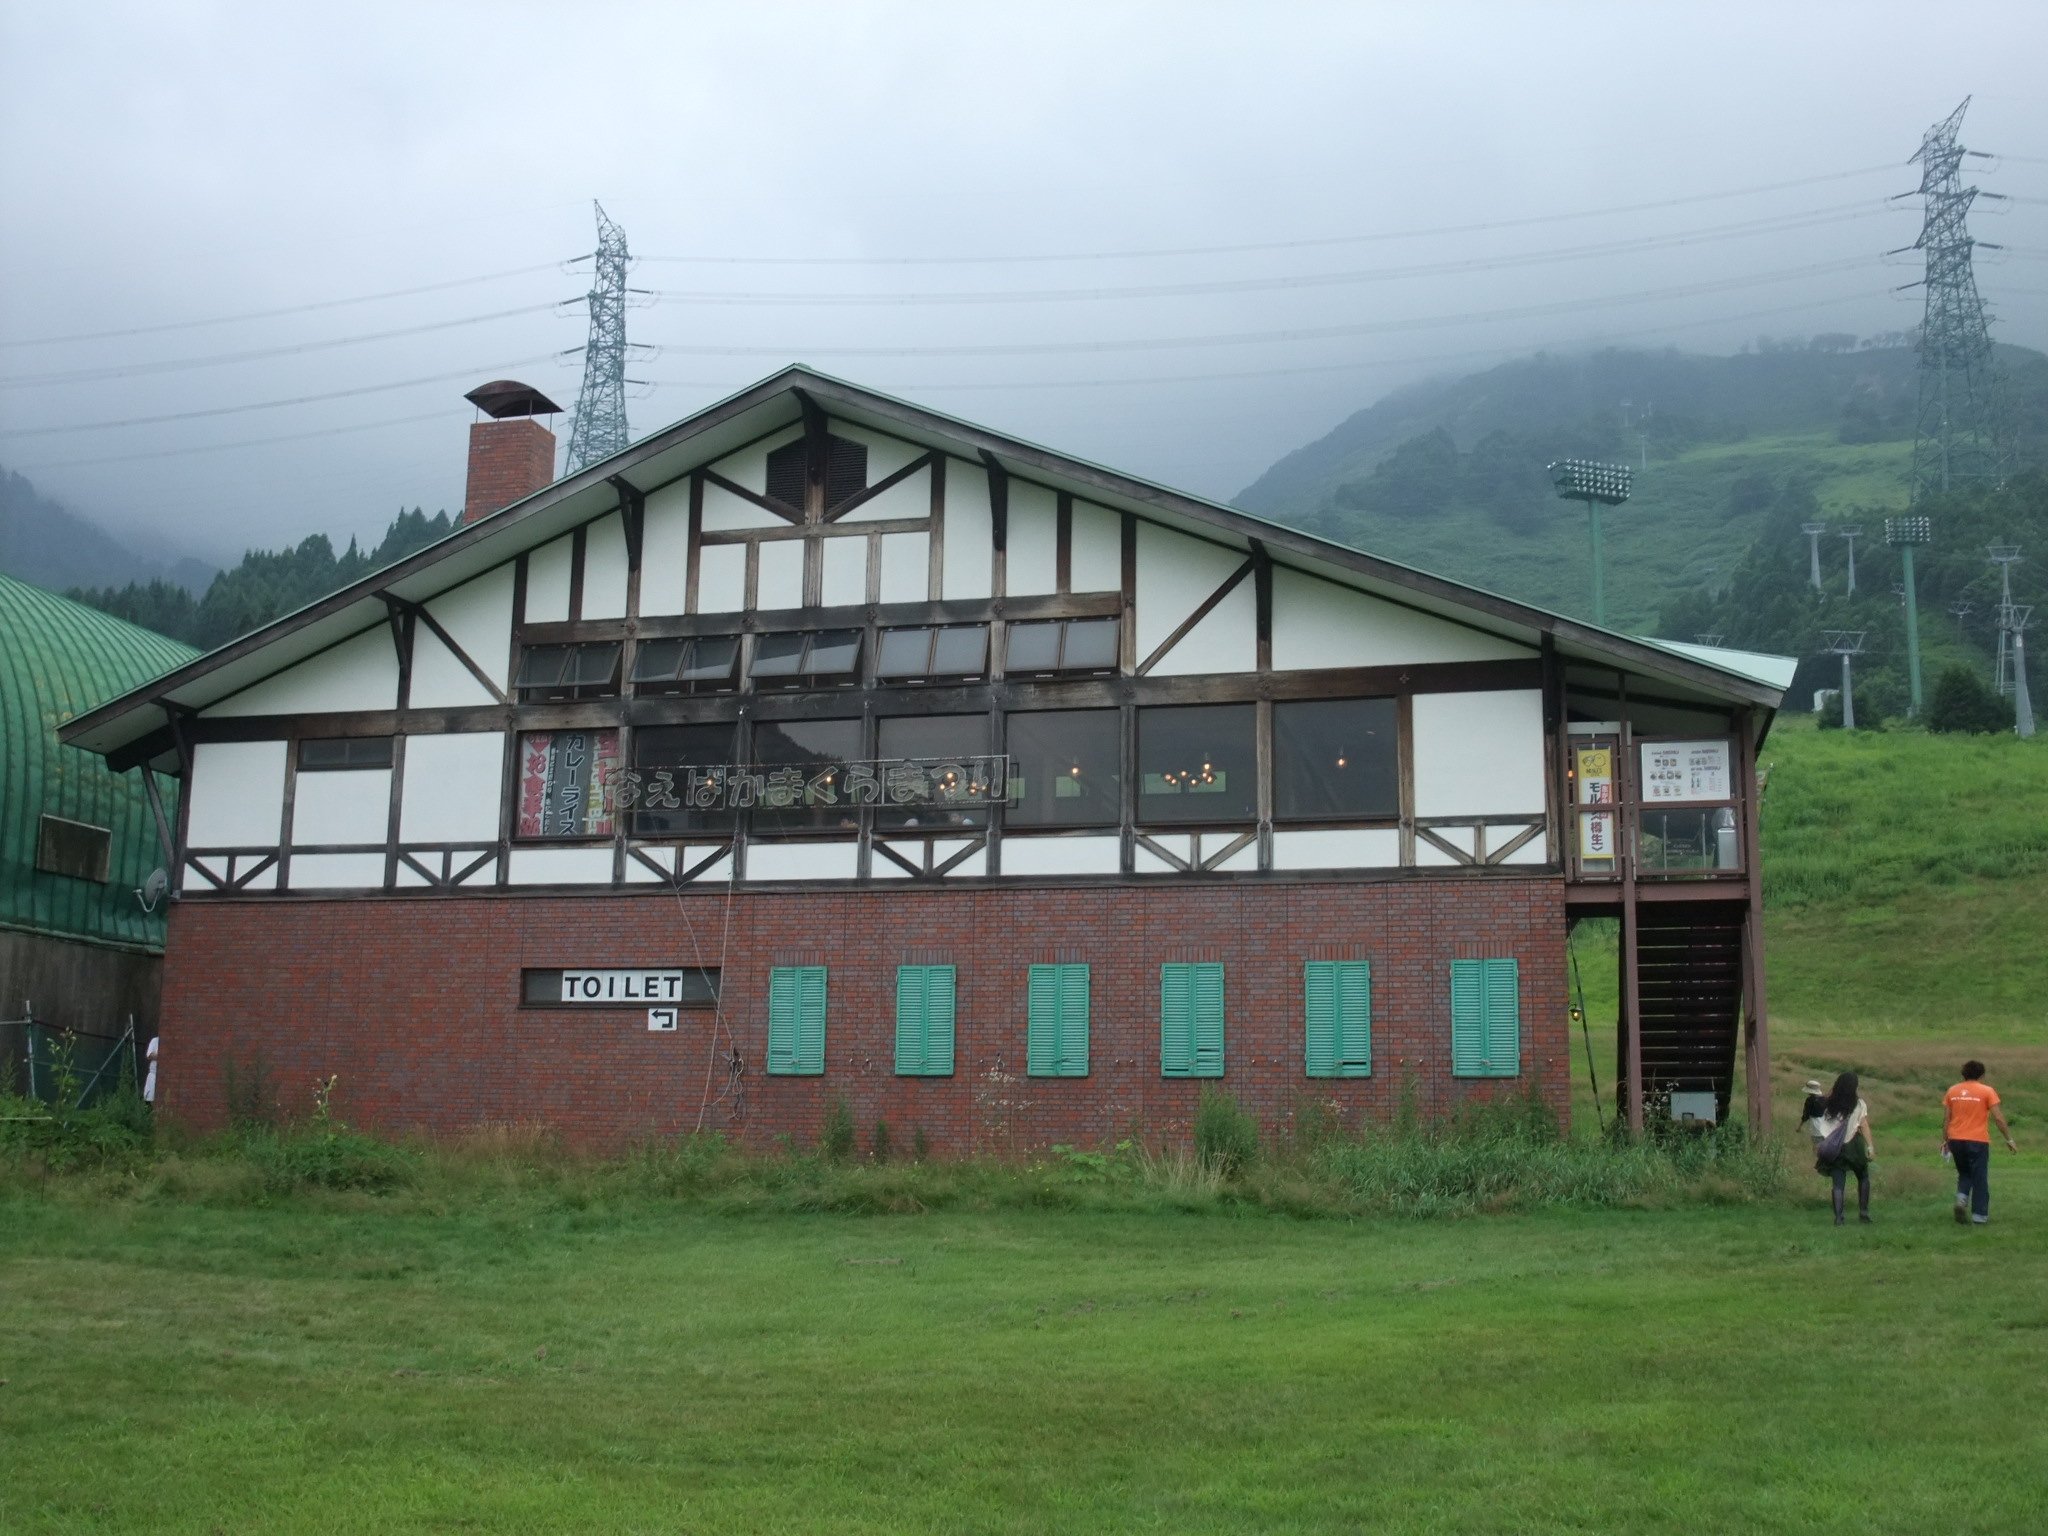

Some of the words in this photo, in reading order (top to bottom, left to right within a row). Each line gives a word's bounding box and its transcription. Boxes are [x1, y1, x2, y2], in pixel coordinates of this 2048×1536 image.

[560, 735, 586, 835] カレーライス
[564, 975, 682, 999] TOILET
